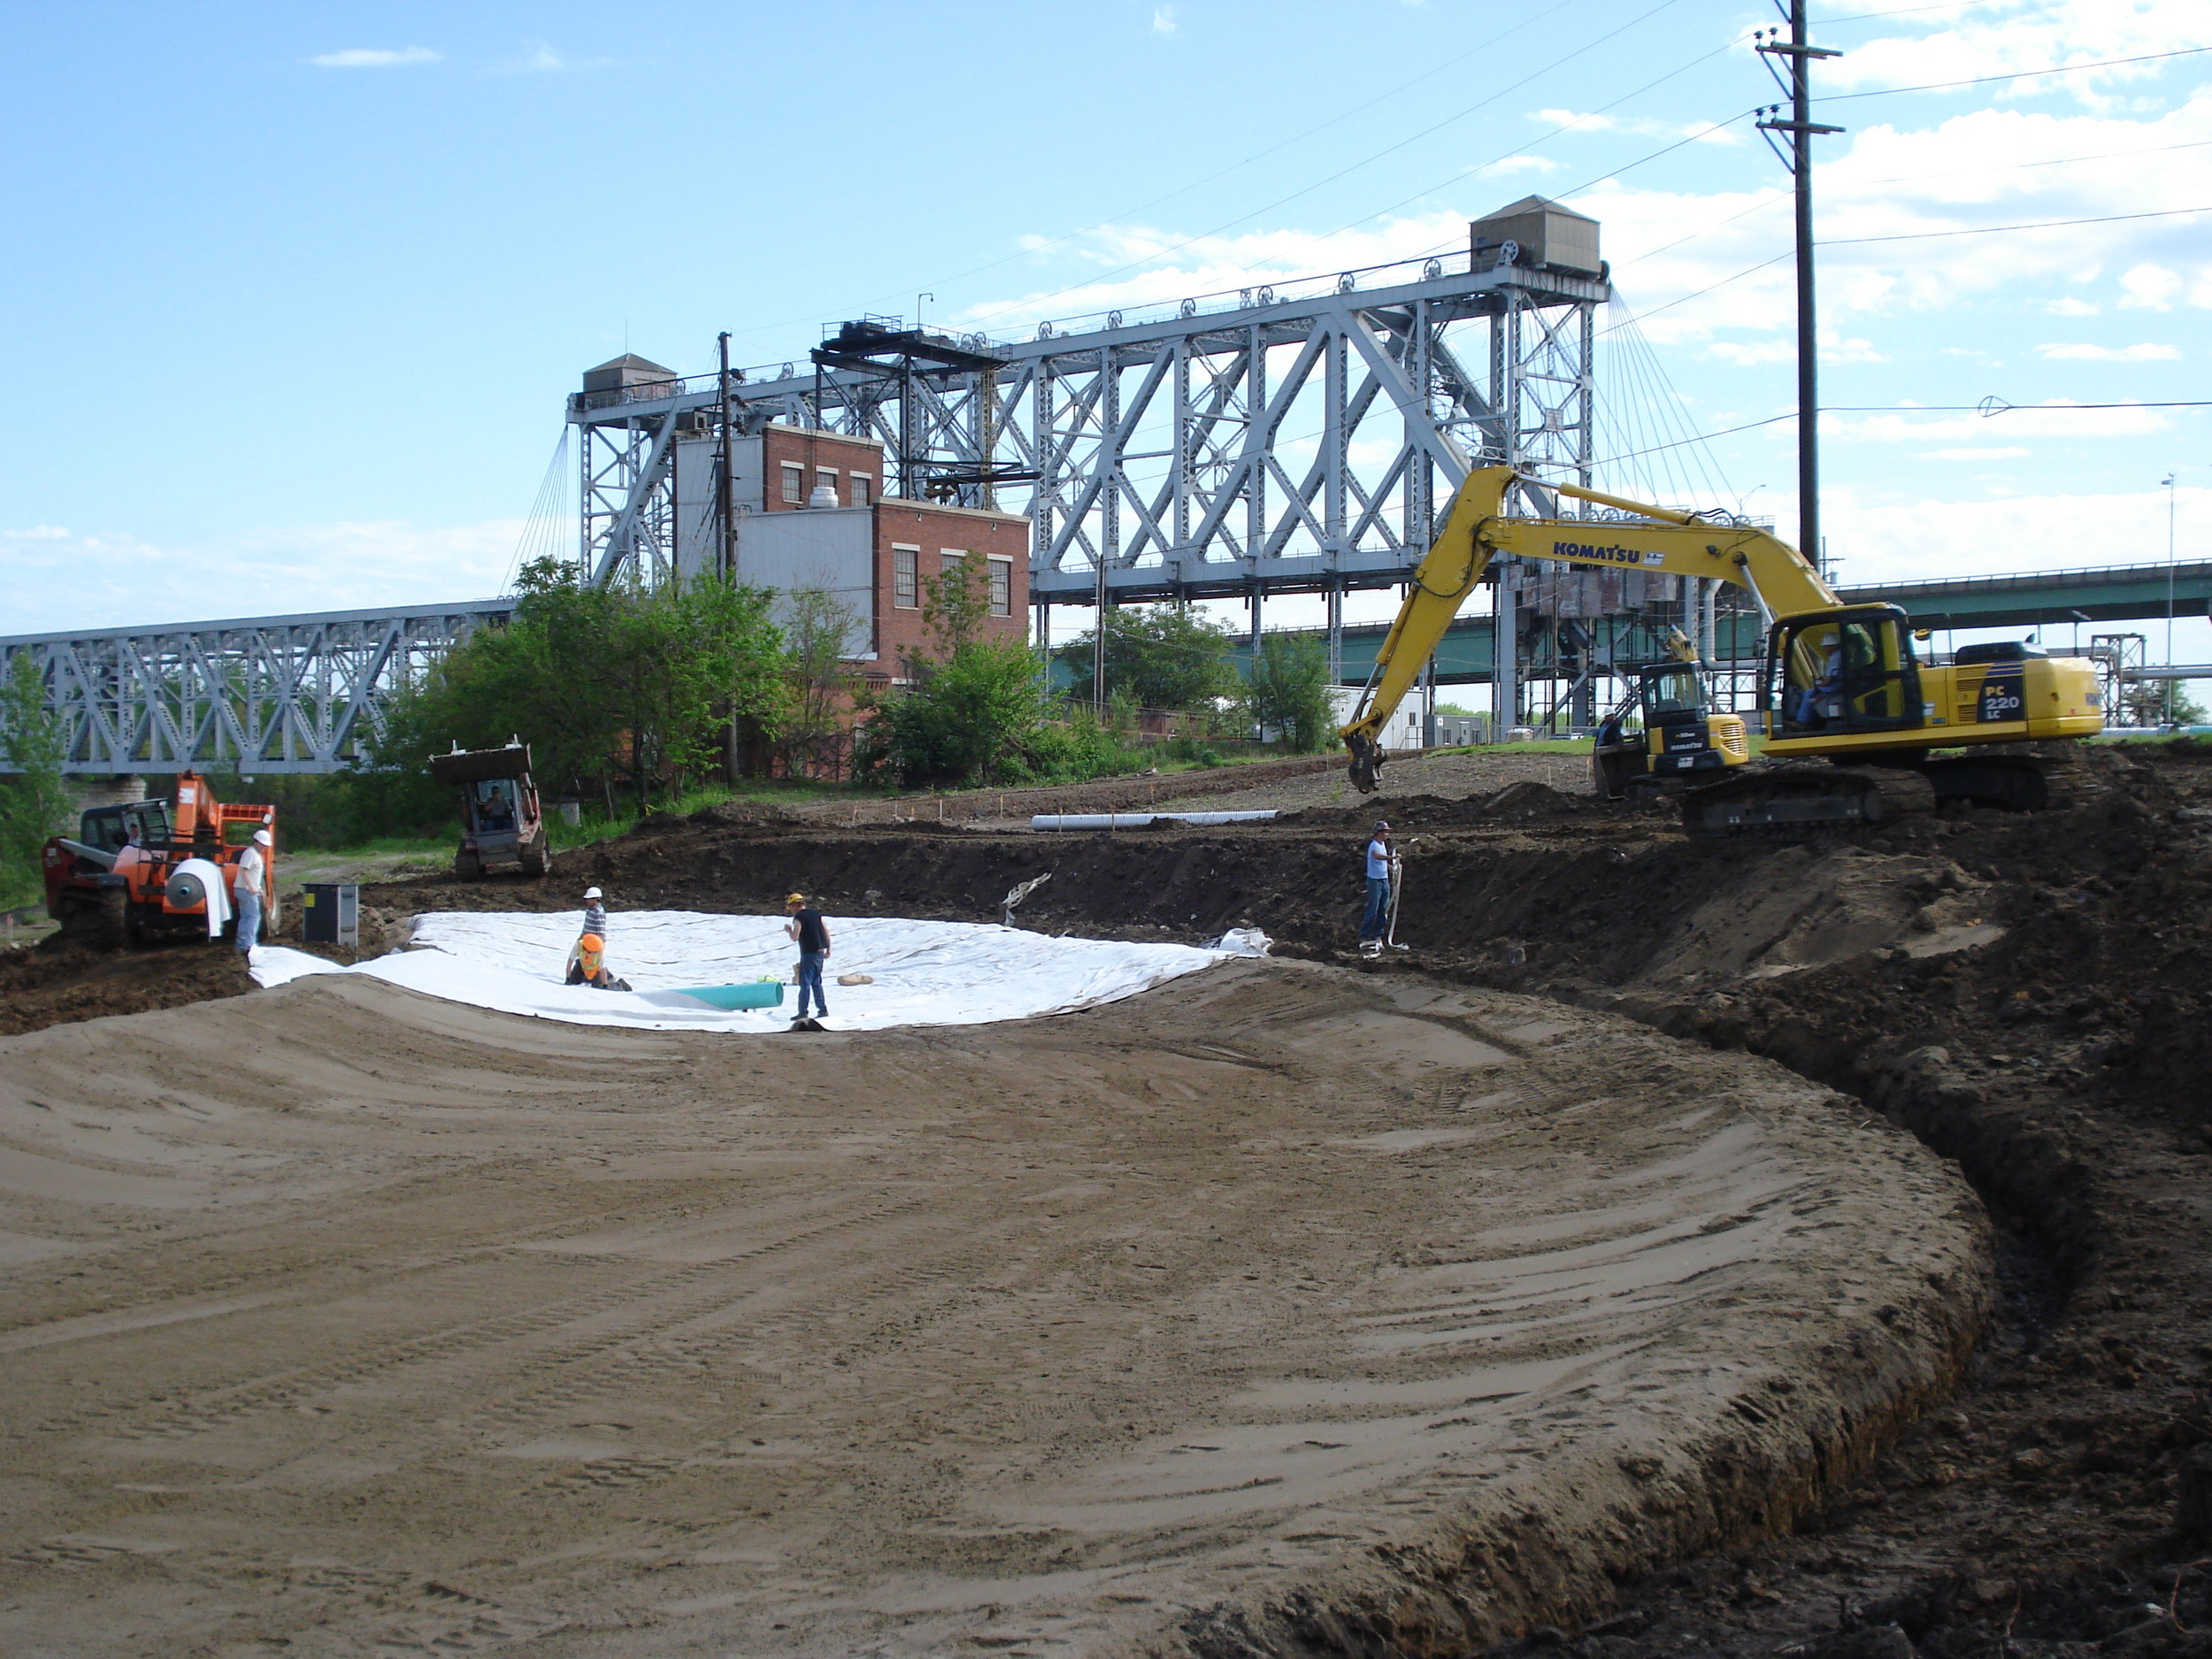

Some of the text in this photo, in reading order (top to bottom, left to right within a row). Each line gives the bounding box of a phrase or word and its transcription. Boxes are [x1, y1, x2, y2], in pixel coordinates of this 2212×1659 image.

[1553, 541, 1640, 564] KOMATSU
[1985, 686, 2004, 696] PC
[1985, 696, 2020, 710] 220
